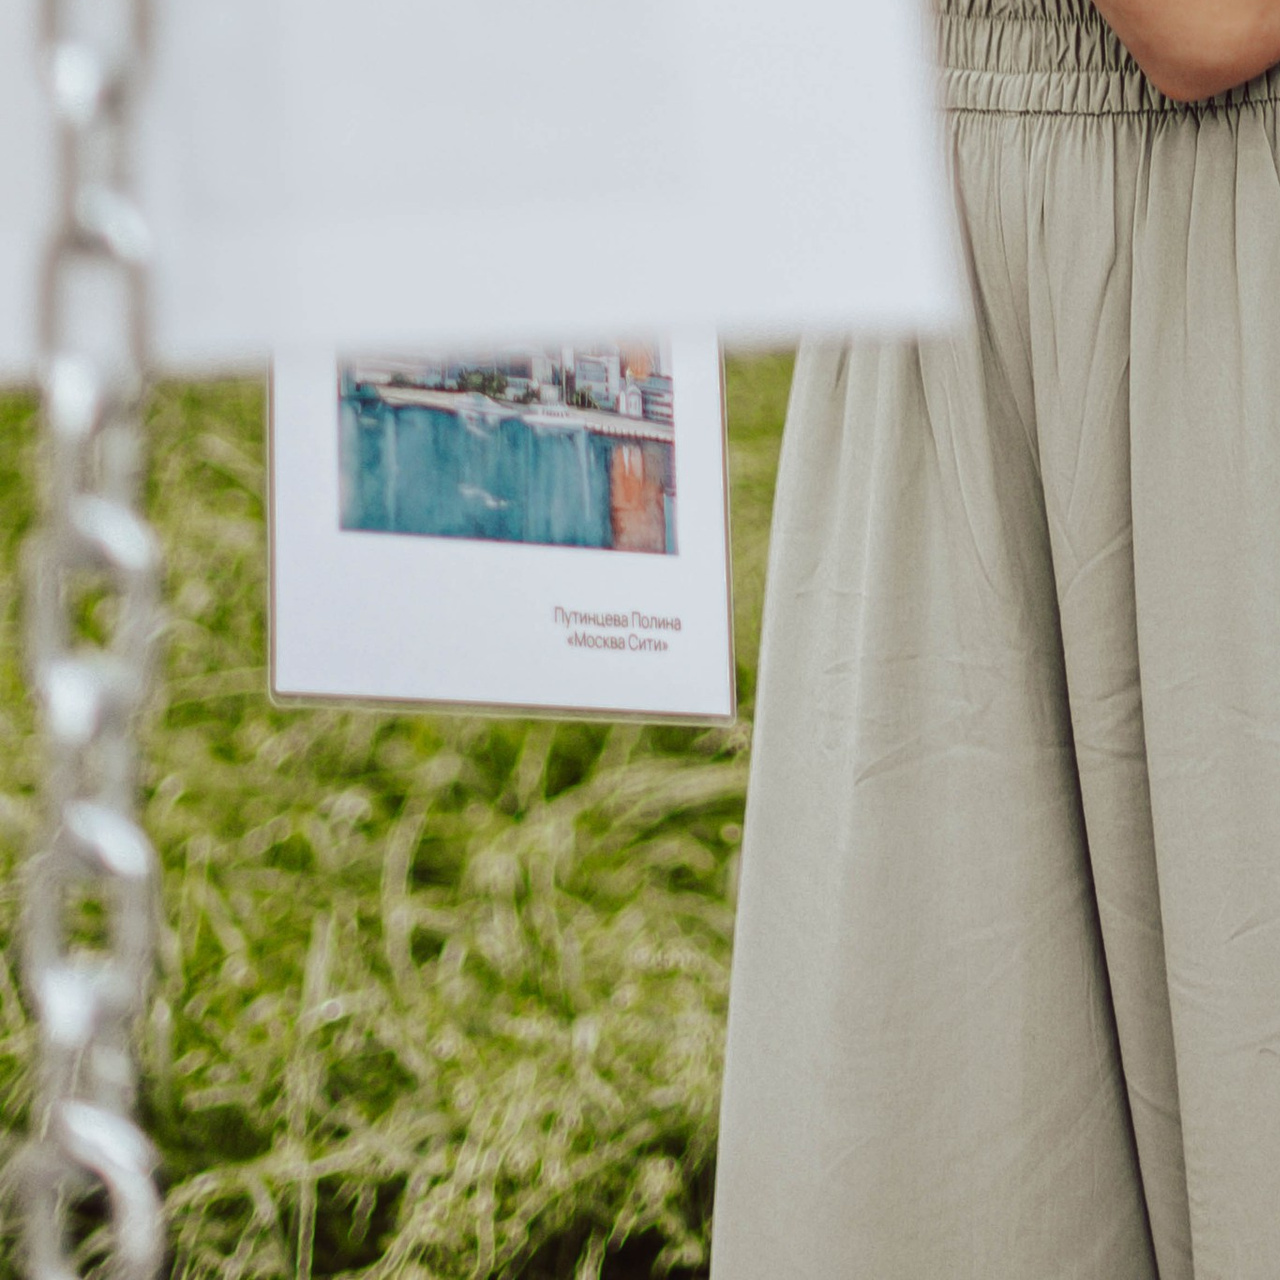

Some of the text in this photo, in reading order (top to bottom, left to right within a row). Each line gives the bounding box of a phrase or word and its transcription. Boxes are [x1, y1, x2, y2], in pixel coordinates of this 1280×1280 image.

[554, 605, 682, 632] Путинцева Полина
[567, 631, 669, 652] «Москва Сити»
